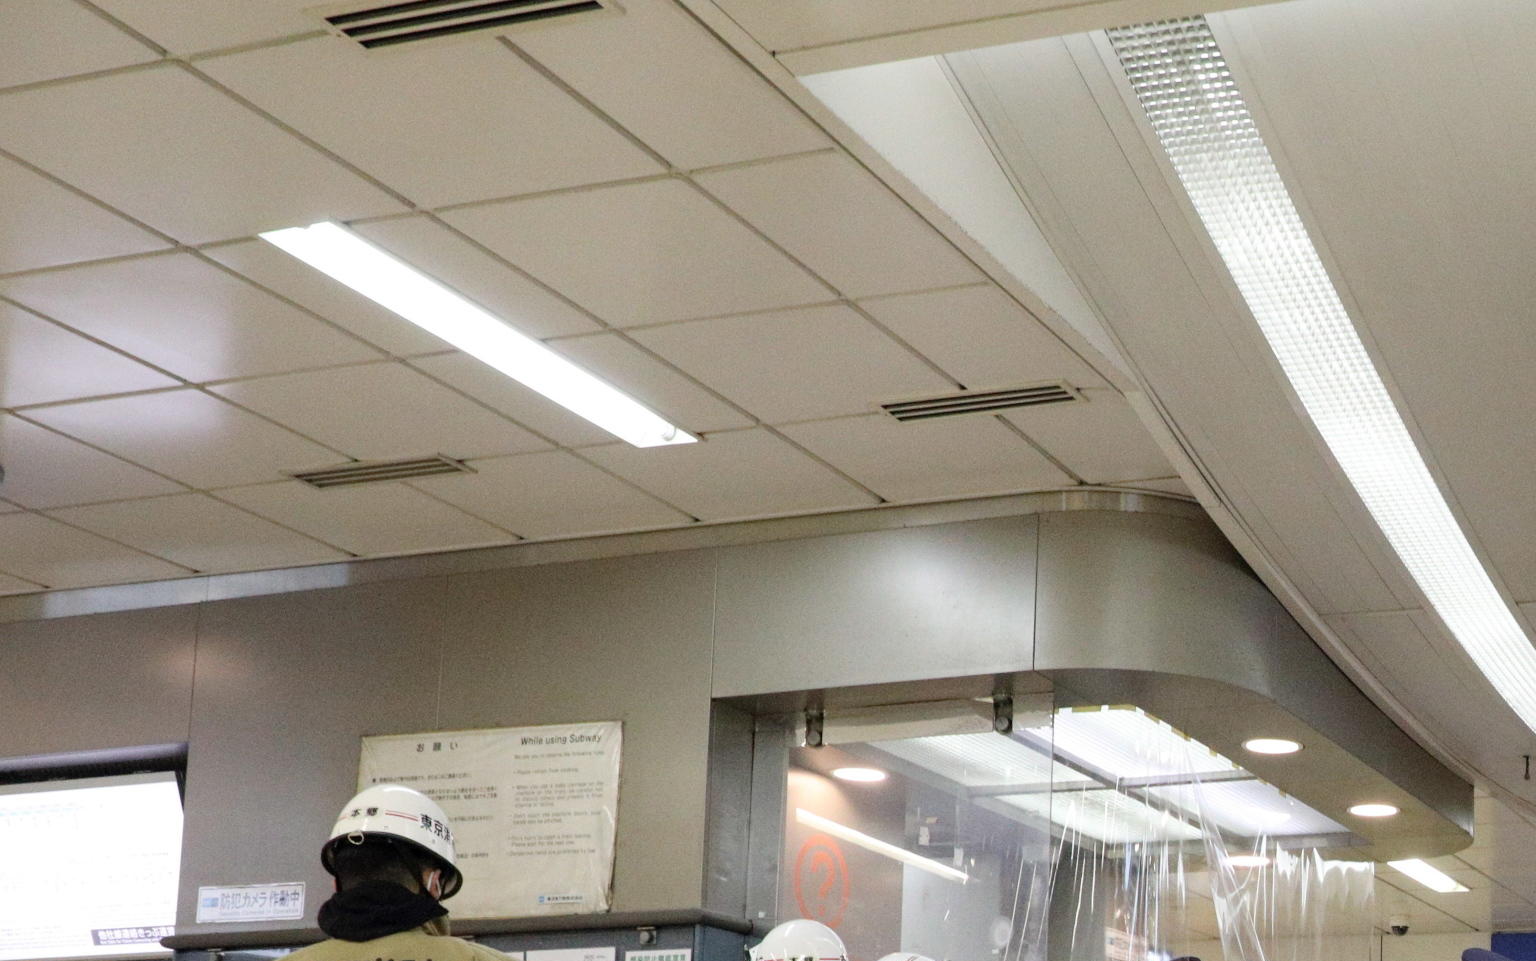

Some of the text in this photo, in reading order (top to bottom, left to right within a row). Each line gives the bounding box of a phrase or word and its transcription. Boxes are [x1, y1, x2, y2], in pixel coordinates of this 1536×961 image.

[521, 733, 602, 745] While using Subway
